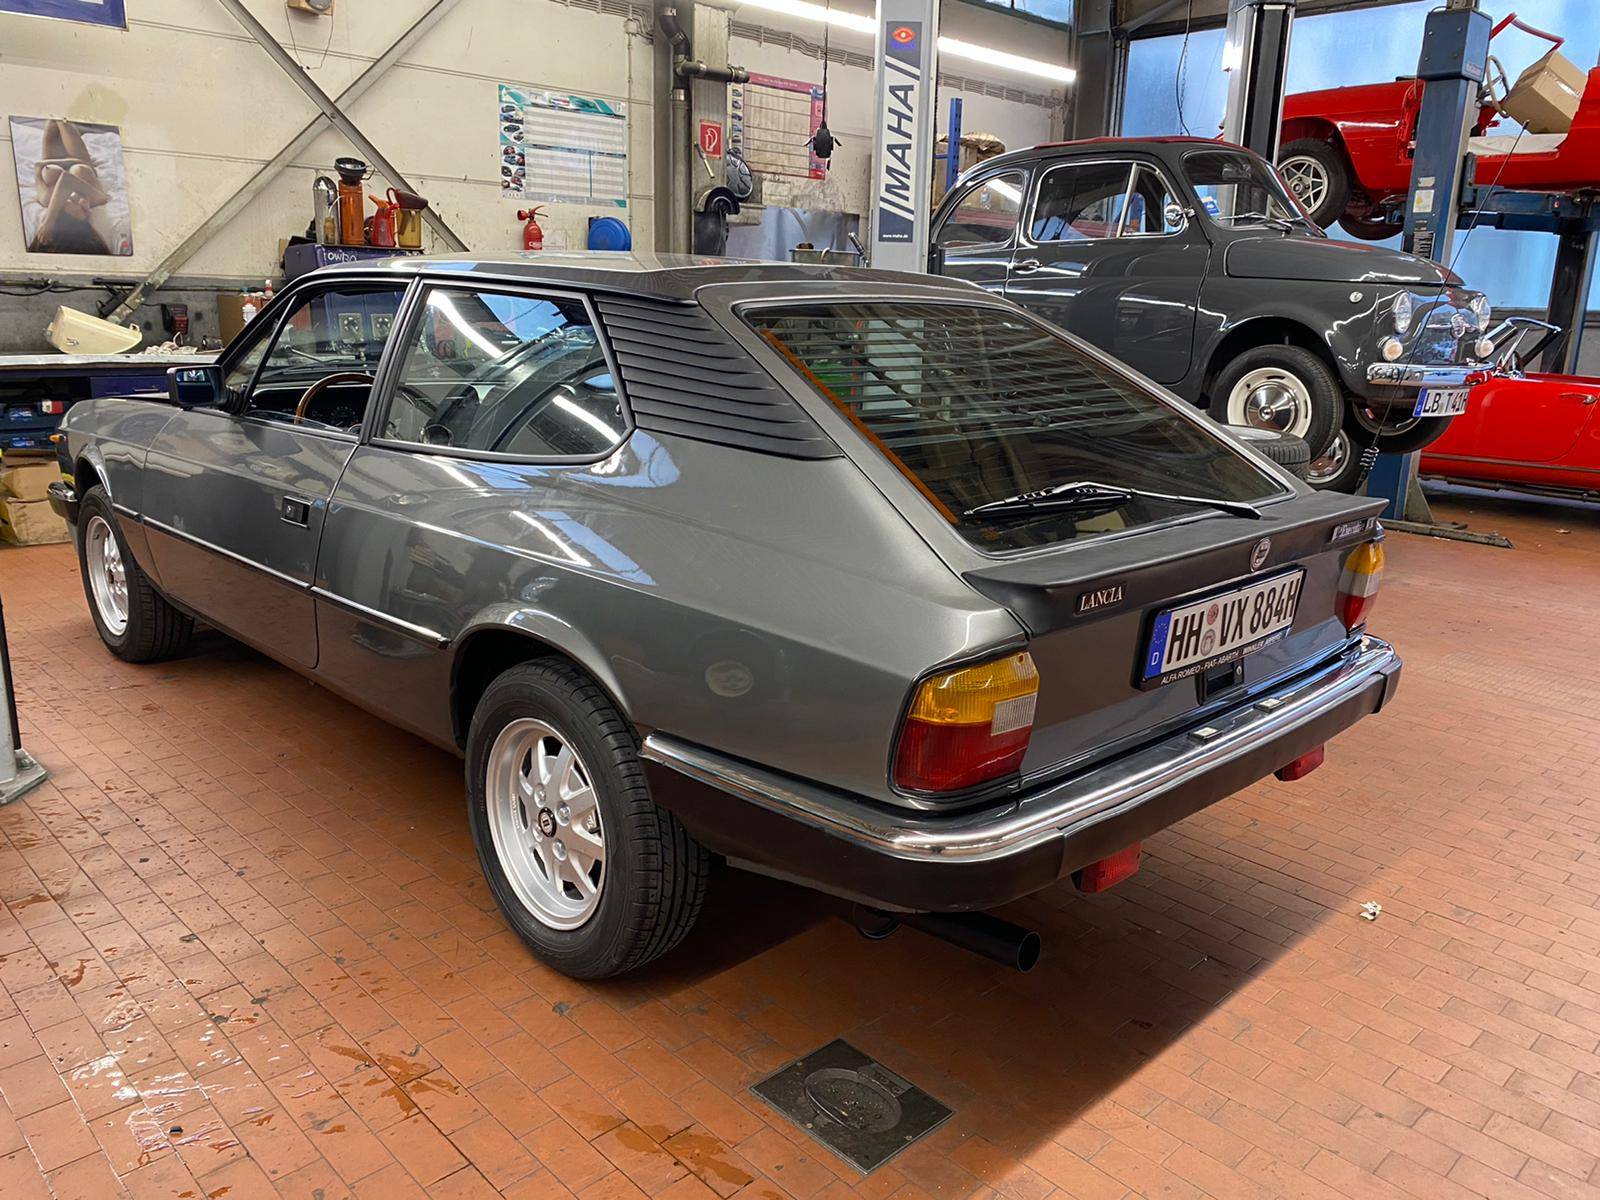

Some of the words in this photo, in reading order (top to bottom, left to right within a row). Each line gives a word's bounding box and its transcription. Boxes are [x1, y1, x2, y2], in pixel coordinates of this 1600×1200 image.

[885, 84, 915, 202] MAHA
[1423, 392, 1442, 413] LB
[1079, 586, 1122, 611] LANCIA
[1166, 611, 1205, 665] HH
[1219, 595, 1250, 647] VX
[1250, 577, 1300, 635] 884H
[1151, 651, 1159, 666] D
[1161, 674, 1178, 685] ALFA
[1178, 664, 1201, 680] ROMEO
